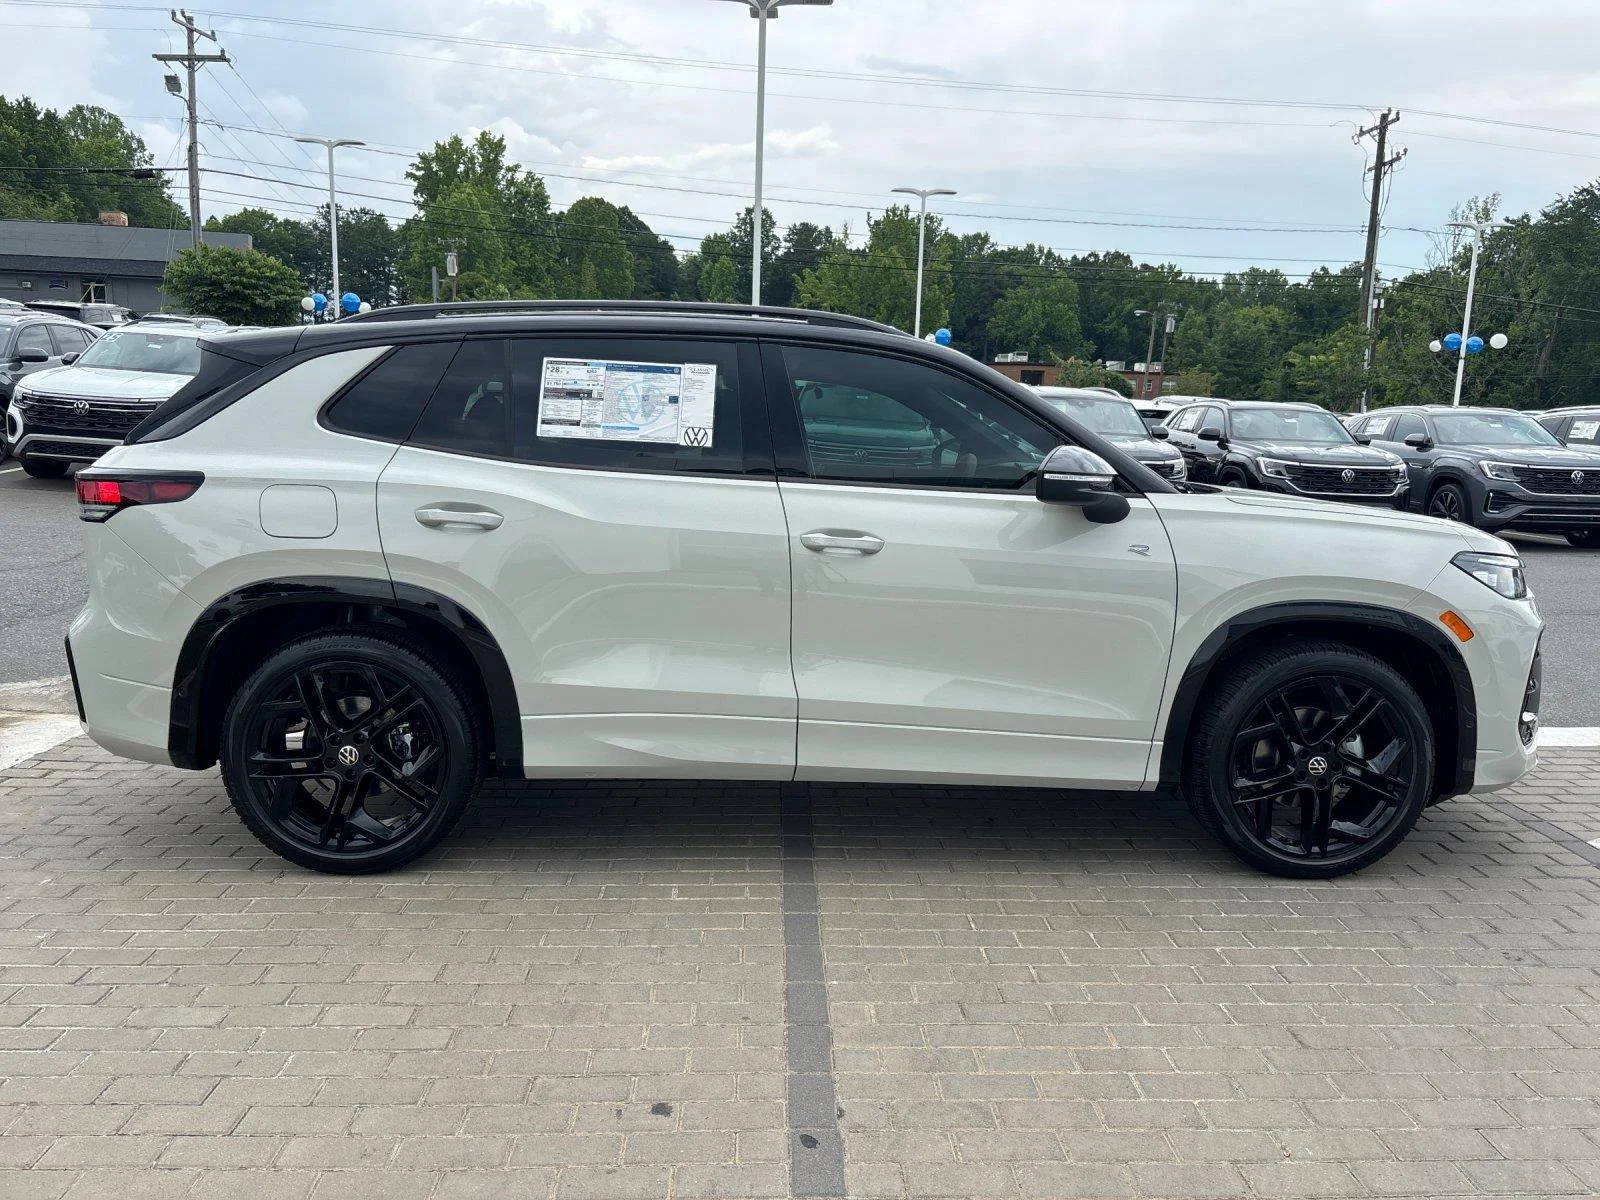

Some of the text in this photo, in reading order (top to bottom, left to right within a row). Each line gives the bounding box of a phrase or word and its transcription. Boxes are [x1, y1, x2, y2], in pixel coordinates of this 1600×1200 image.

[74, 400, 90, 416] VW
[684, 427, 708, 446] VW
[338, 745, 359, 766] VW
[1308, 756, 1327, 776] VW
